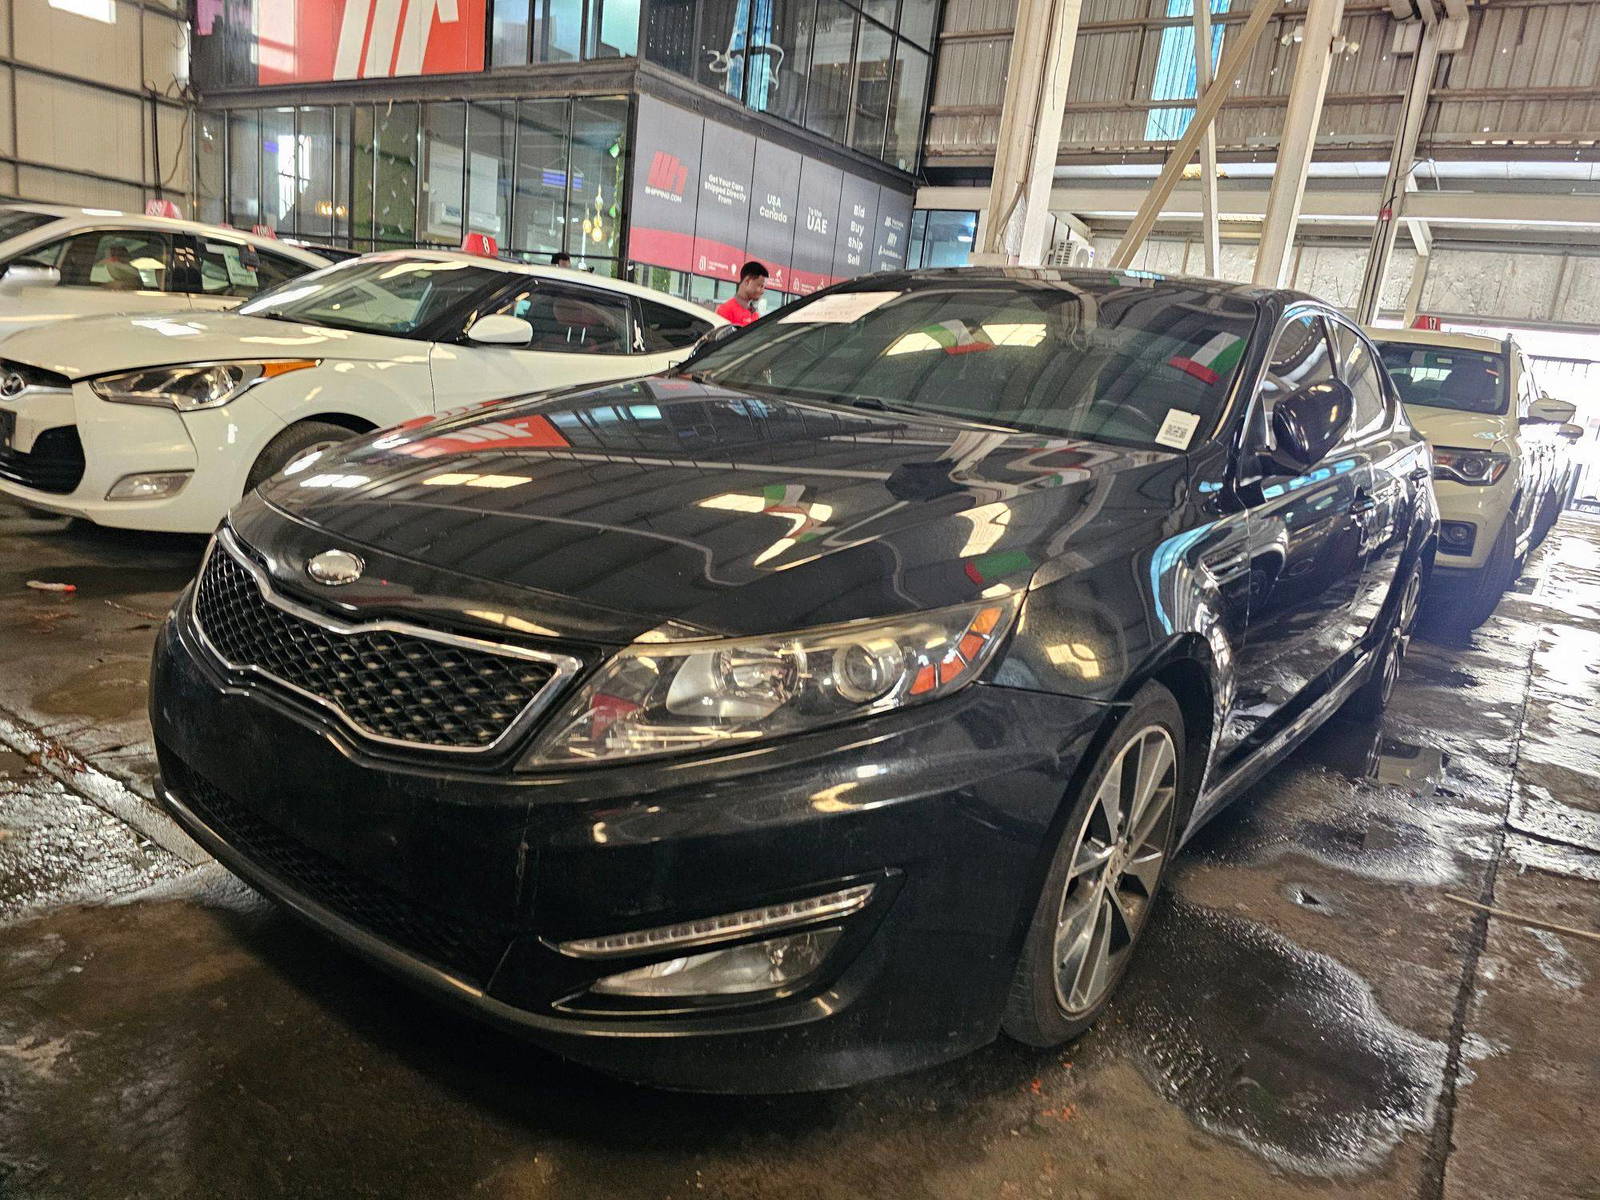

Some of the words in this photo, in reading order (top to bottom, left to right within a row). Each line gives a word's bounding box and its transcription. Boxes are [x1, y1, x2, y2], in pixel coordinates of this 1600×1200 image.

[767, 193, 781, 208] USA
[759, 205, 787, 223] Canada
[853, 203, 865, 218] Bid
[806, 214, 828, 234] UAE
[850, 220, 864, 237] Buy
[847, 236, 864, 254] Ship
[847, 253, 860, 266] Sell
[1428, 317, 1437, 330] 17
